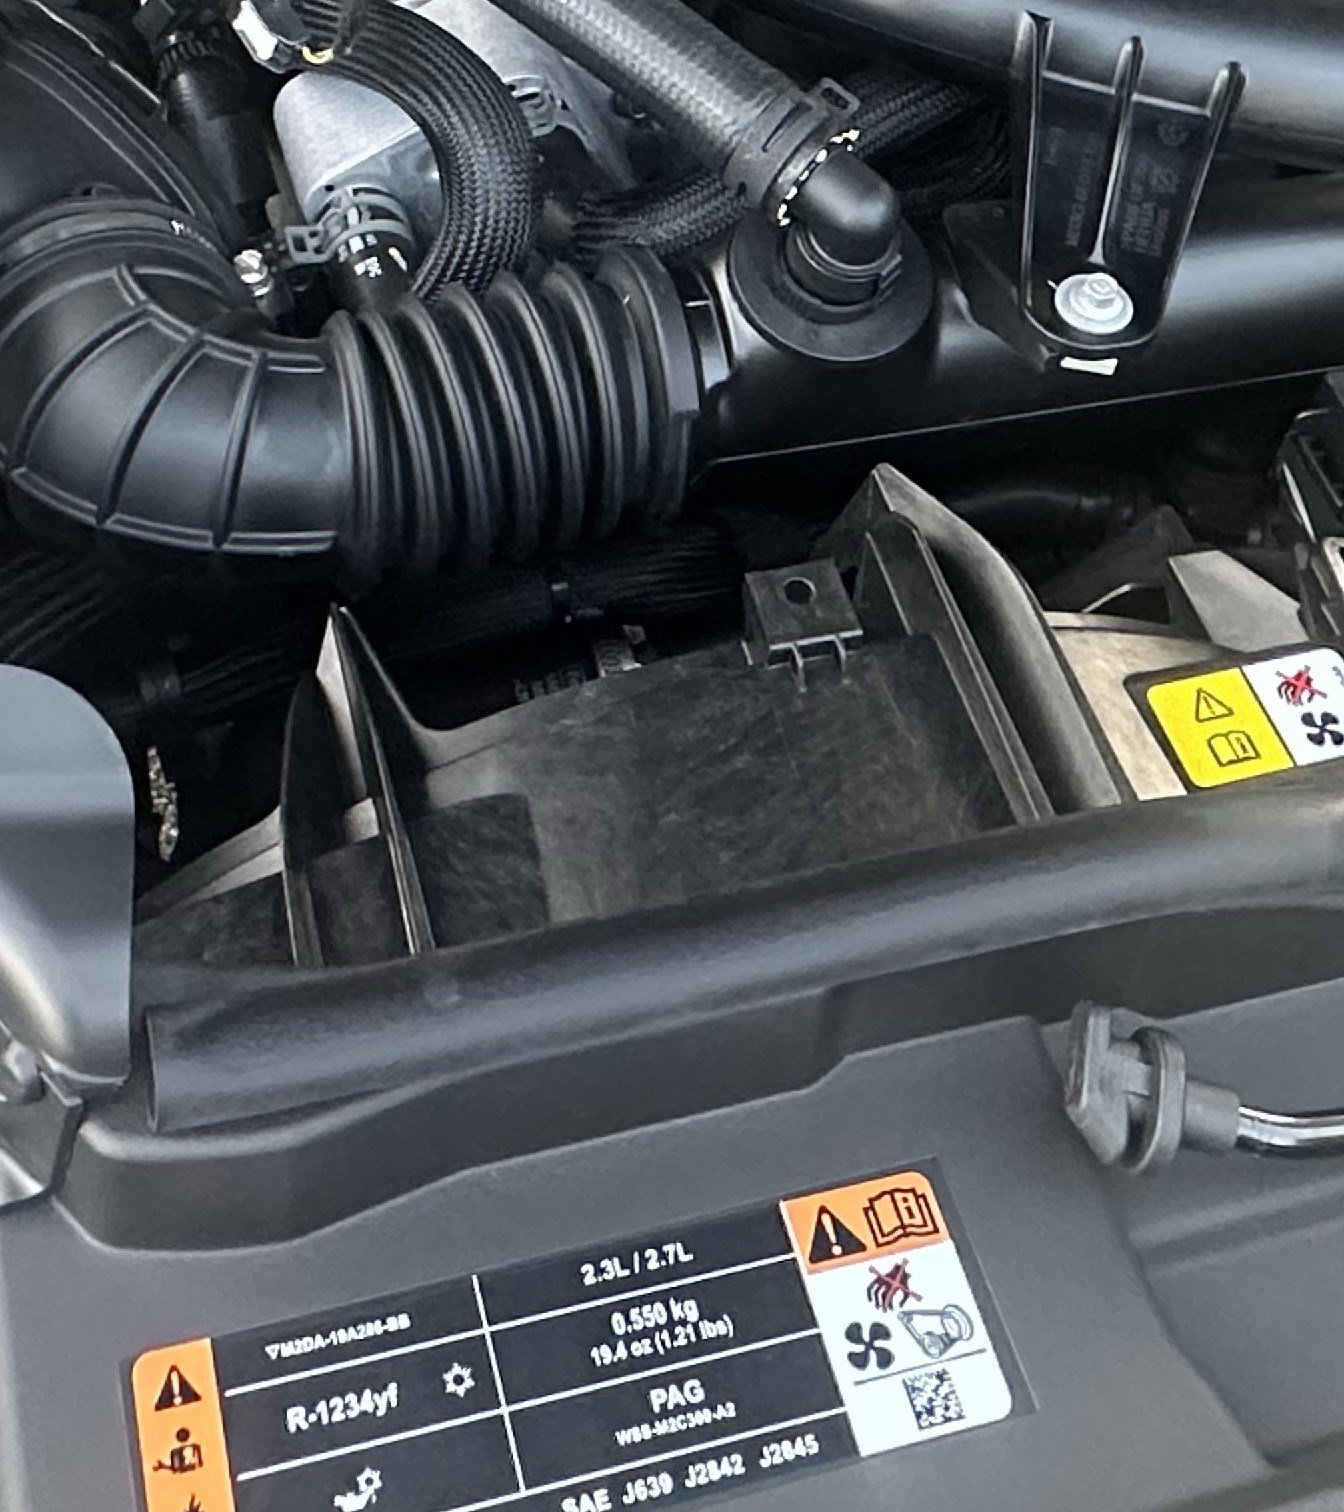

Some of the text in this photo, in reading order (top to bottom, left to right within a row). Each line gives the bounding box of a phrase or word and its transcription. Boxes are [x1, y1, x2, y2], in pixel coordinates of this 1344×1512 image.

[580, 1241, 694, 1286] 2.3L / 2.7L
[590, 1313, 735, 1367] 19.4 oz (1.21 lbs)
[610, 1296, 699, 1336] 0.550 kg
[285, 1381, 398, 1434] R-1234yf
[648, 1378, 706, 1413] PAG
[560, 1433, 820, 1512] SAE J639 J2842 J2845
